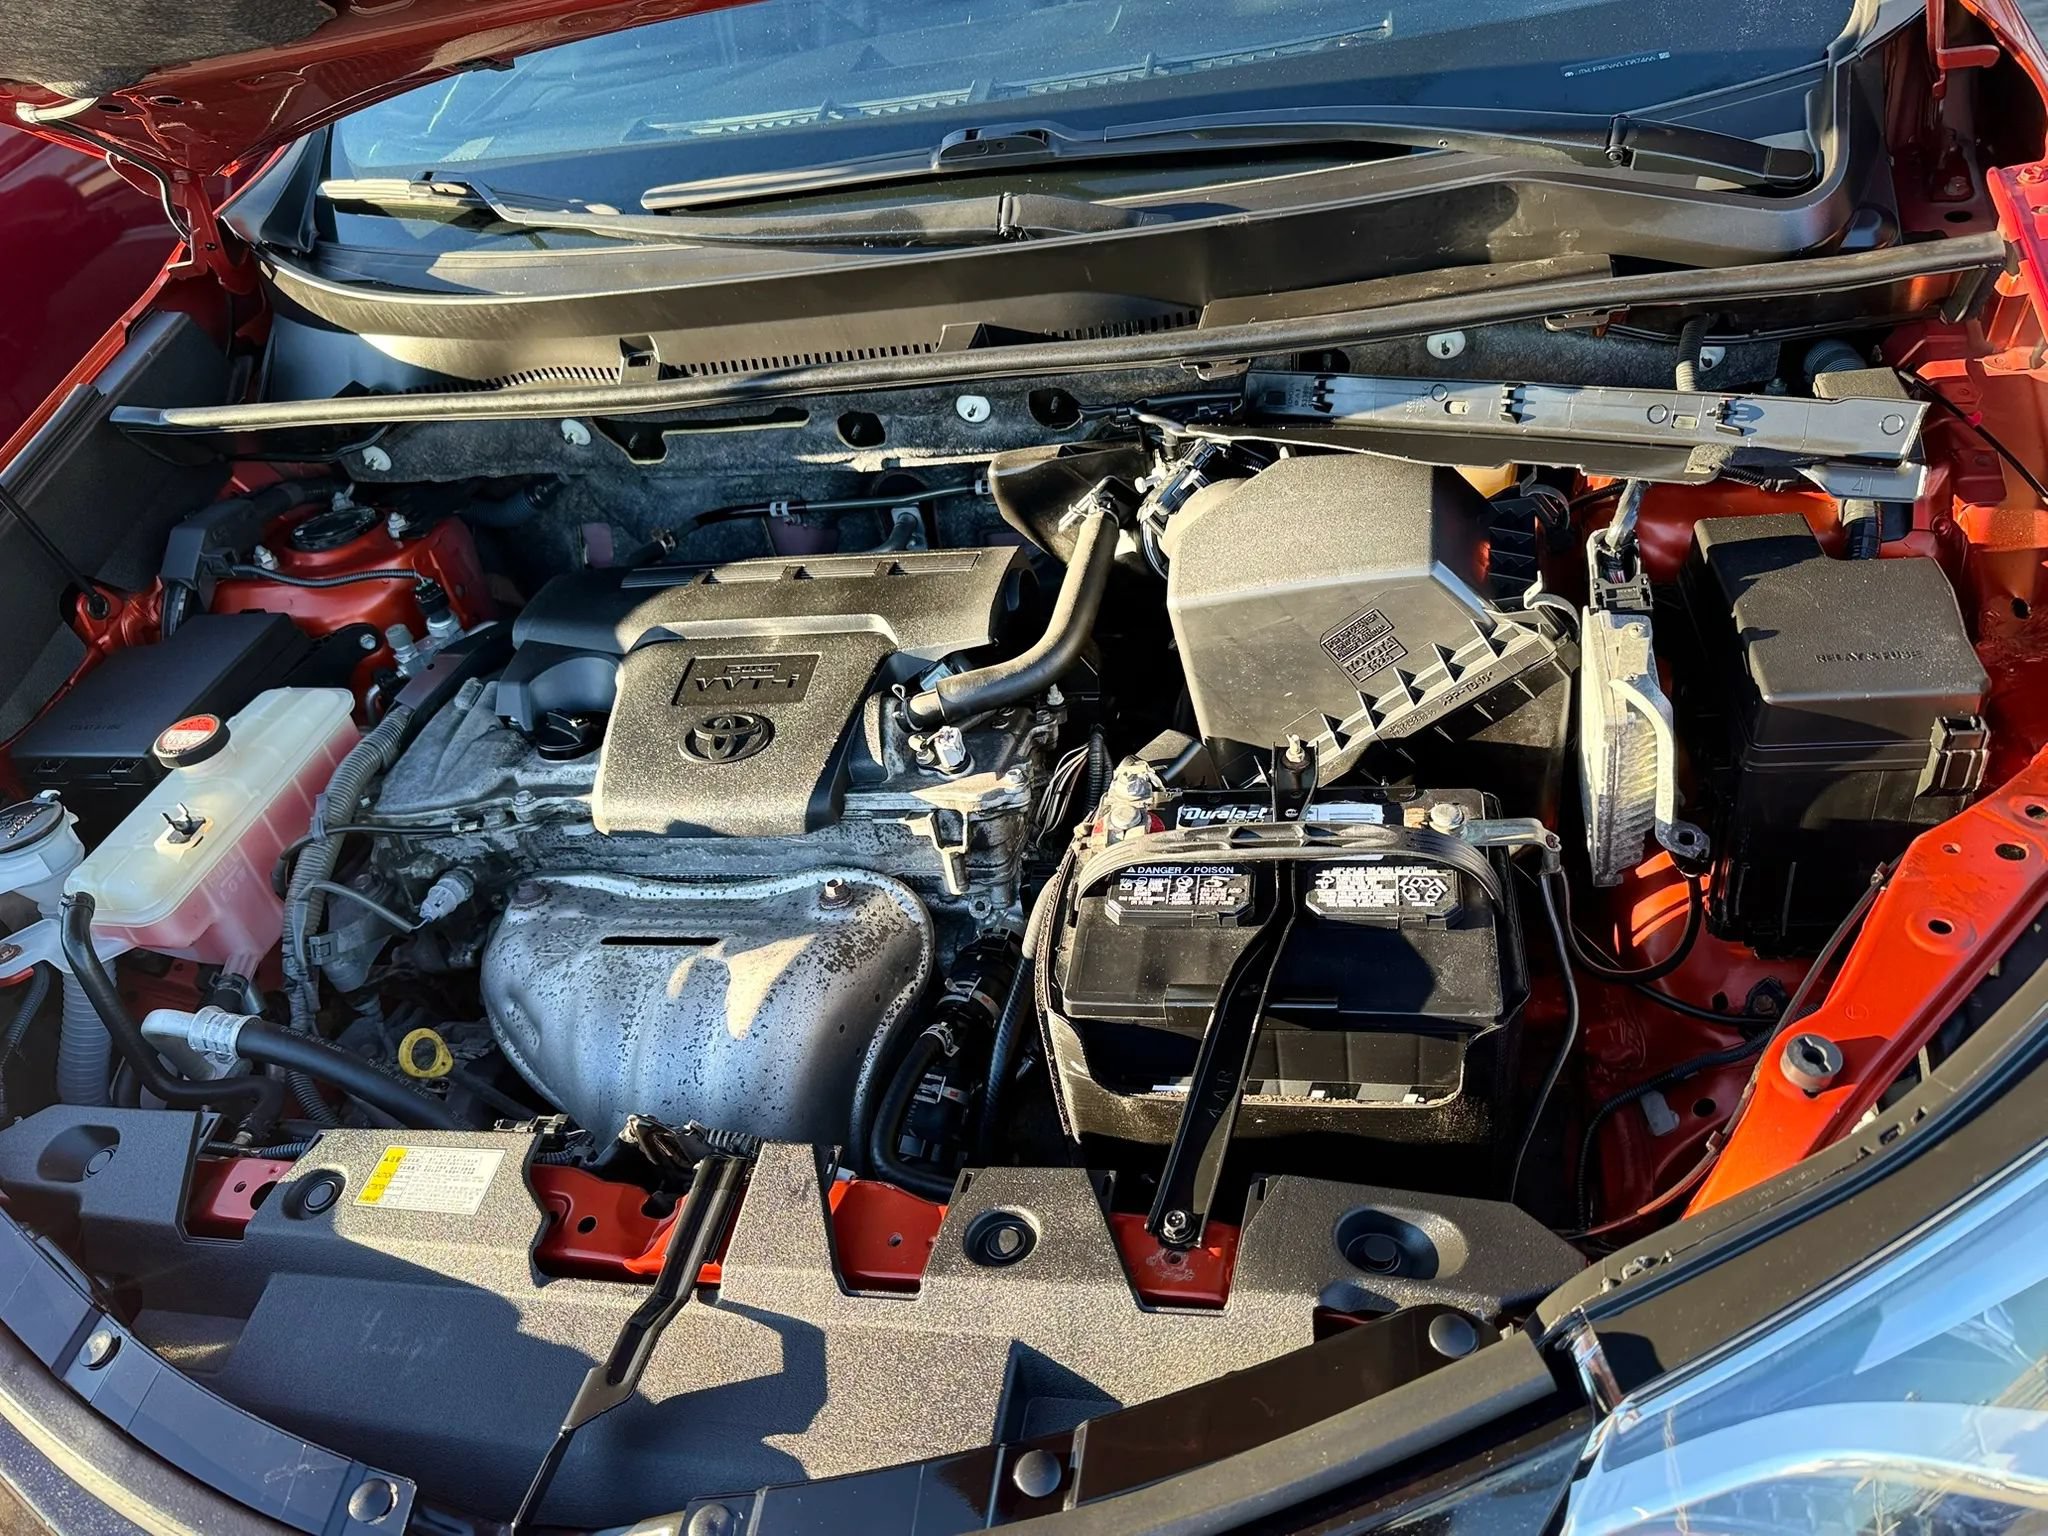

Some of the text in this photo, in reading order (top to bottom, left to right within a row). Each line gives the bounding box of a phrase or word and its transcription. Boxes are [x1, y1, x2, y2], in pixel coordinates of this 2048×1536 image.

[1346, 637, 1397, 672] TOYOTA
[1183, 807, 1267, 822] Duralast
[1137, 866, 1182, 874] DANGER
[1193, 866, 1235, 874] POISON
